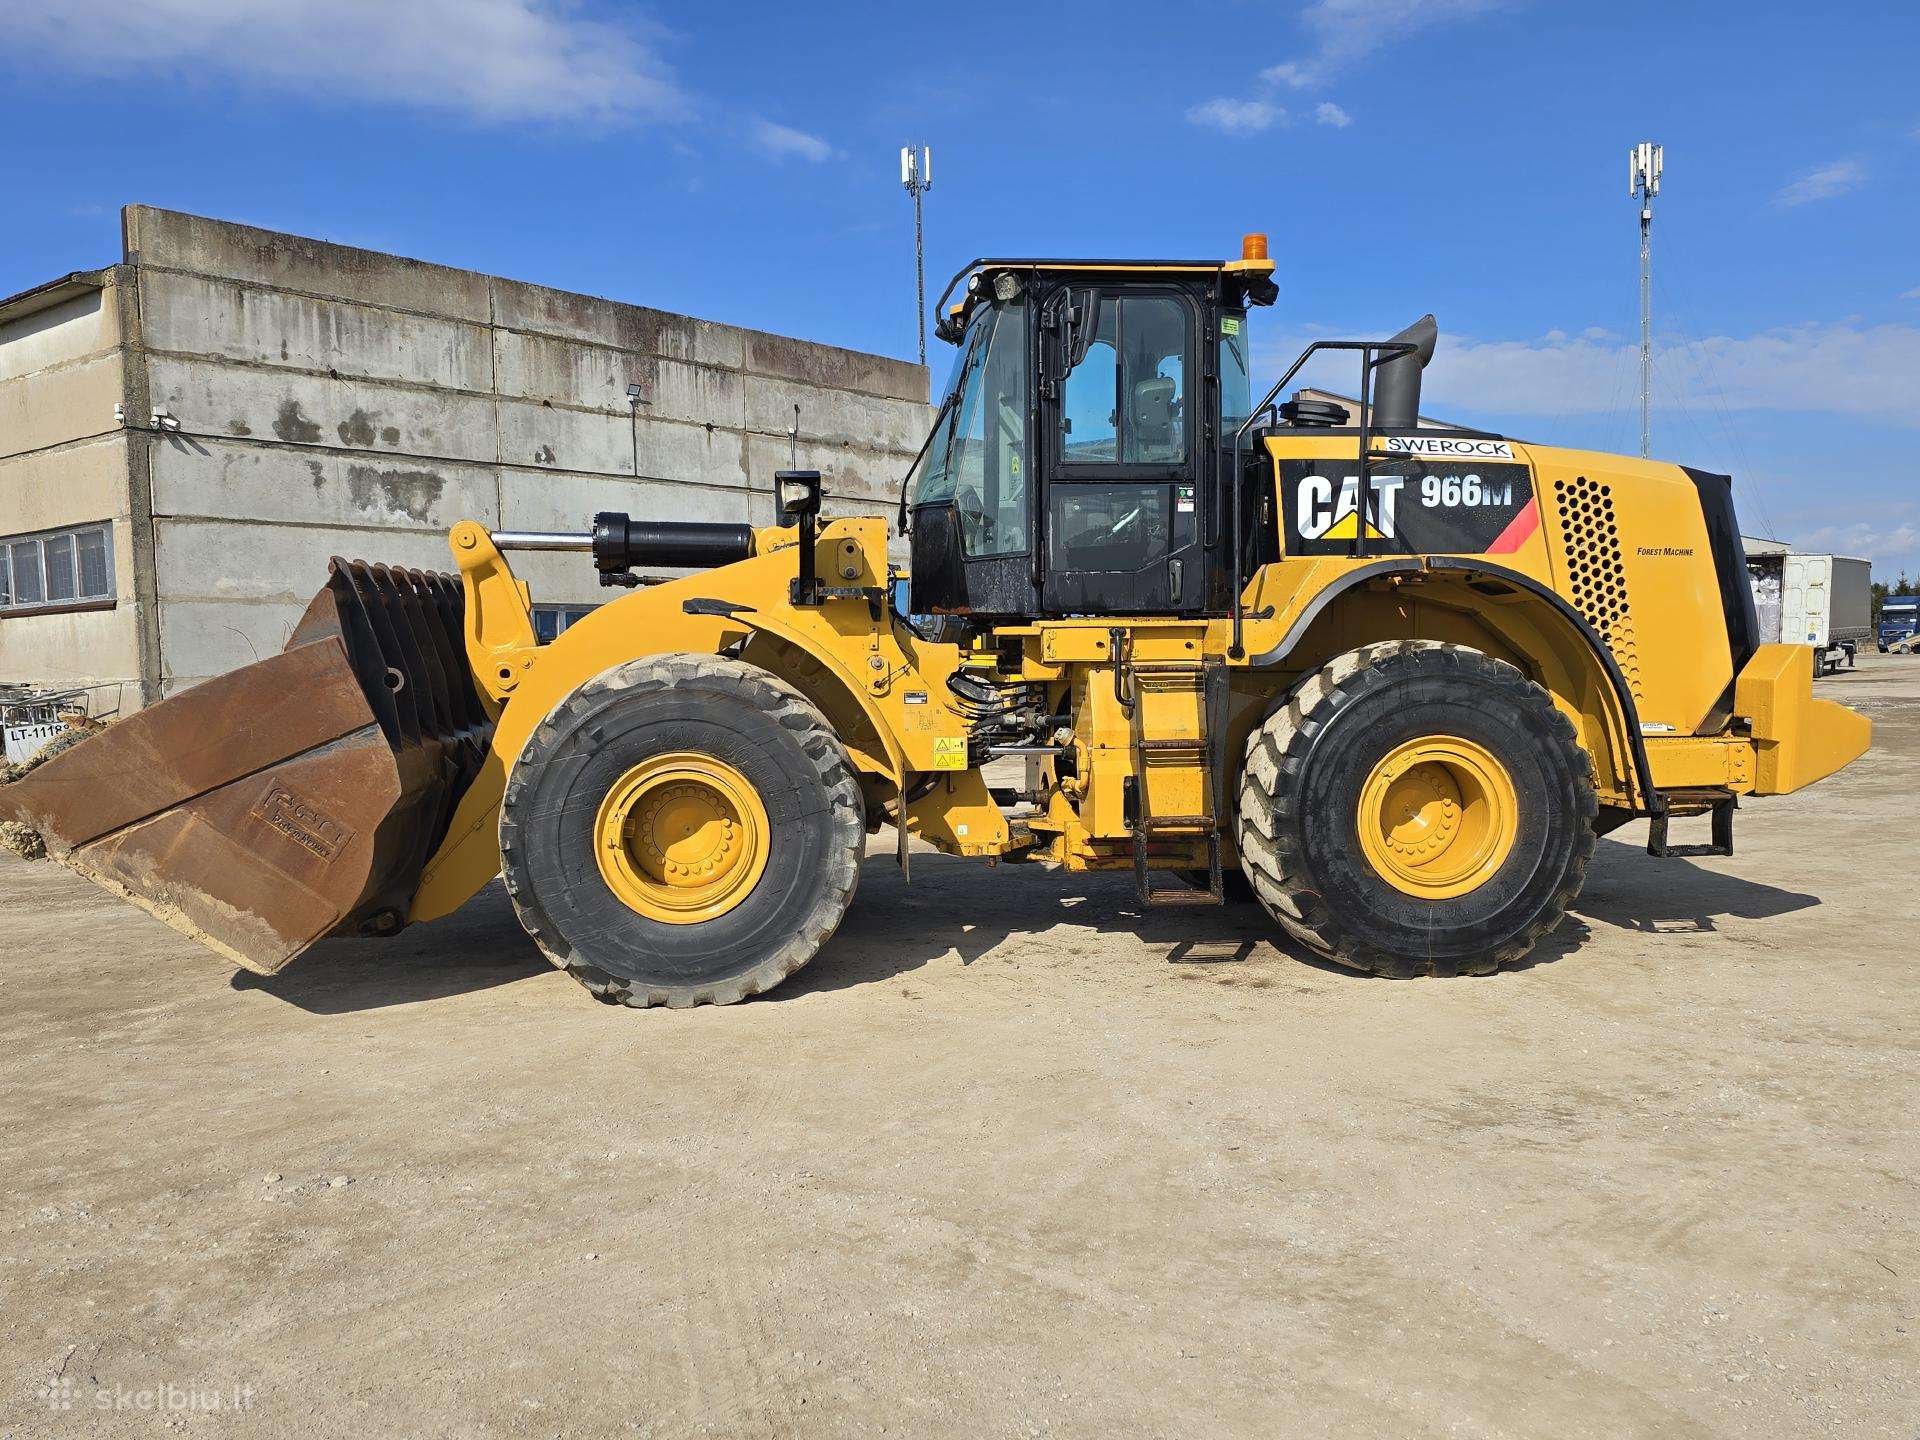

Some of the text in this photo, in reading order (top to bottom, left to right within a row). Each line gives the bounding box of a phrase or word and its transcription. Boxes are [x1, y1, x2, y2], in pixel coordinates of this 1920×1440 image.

[1388, 438, 1510, 456] SWEROCK
[1297, 475, 1405, 540] CAT
[1421, 474, 1512, 508] 966M
